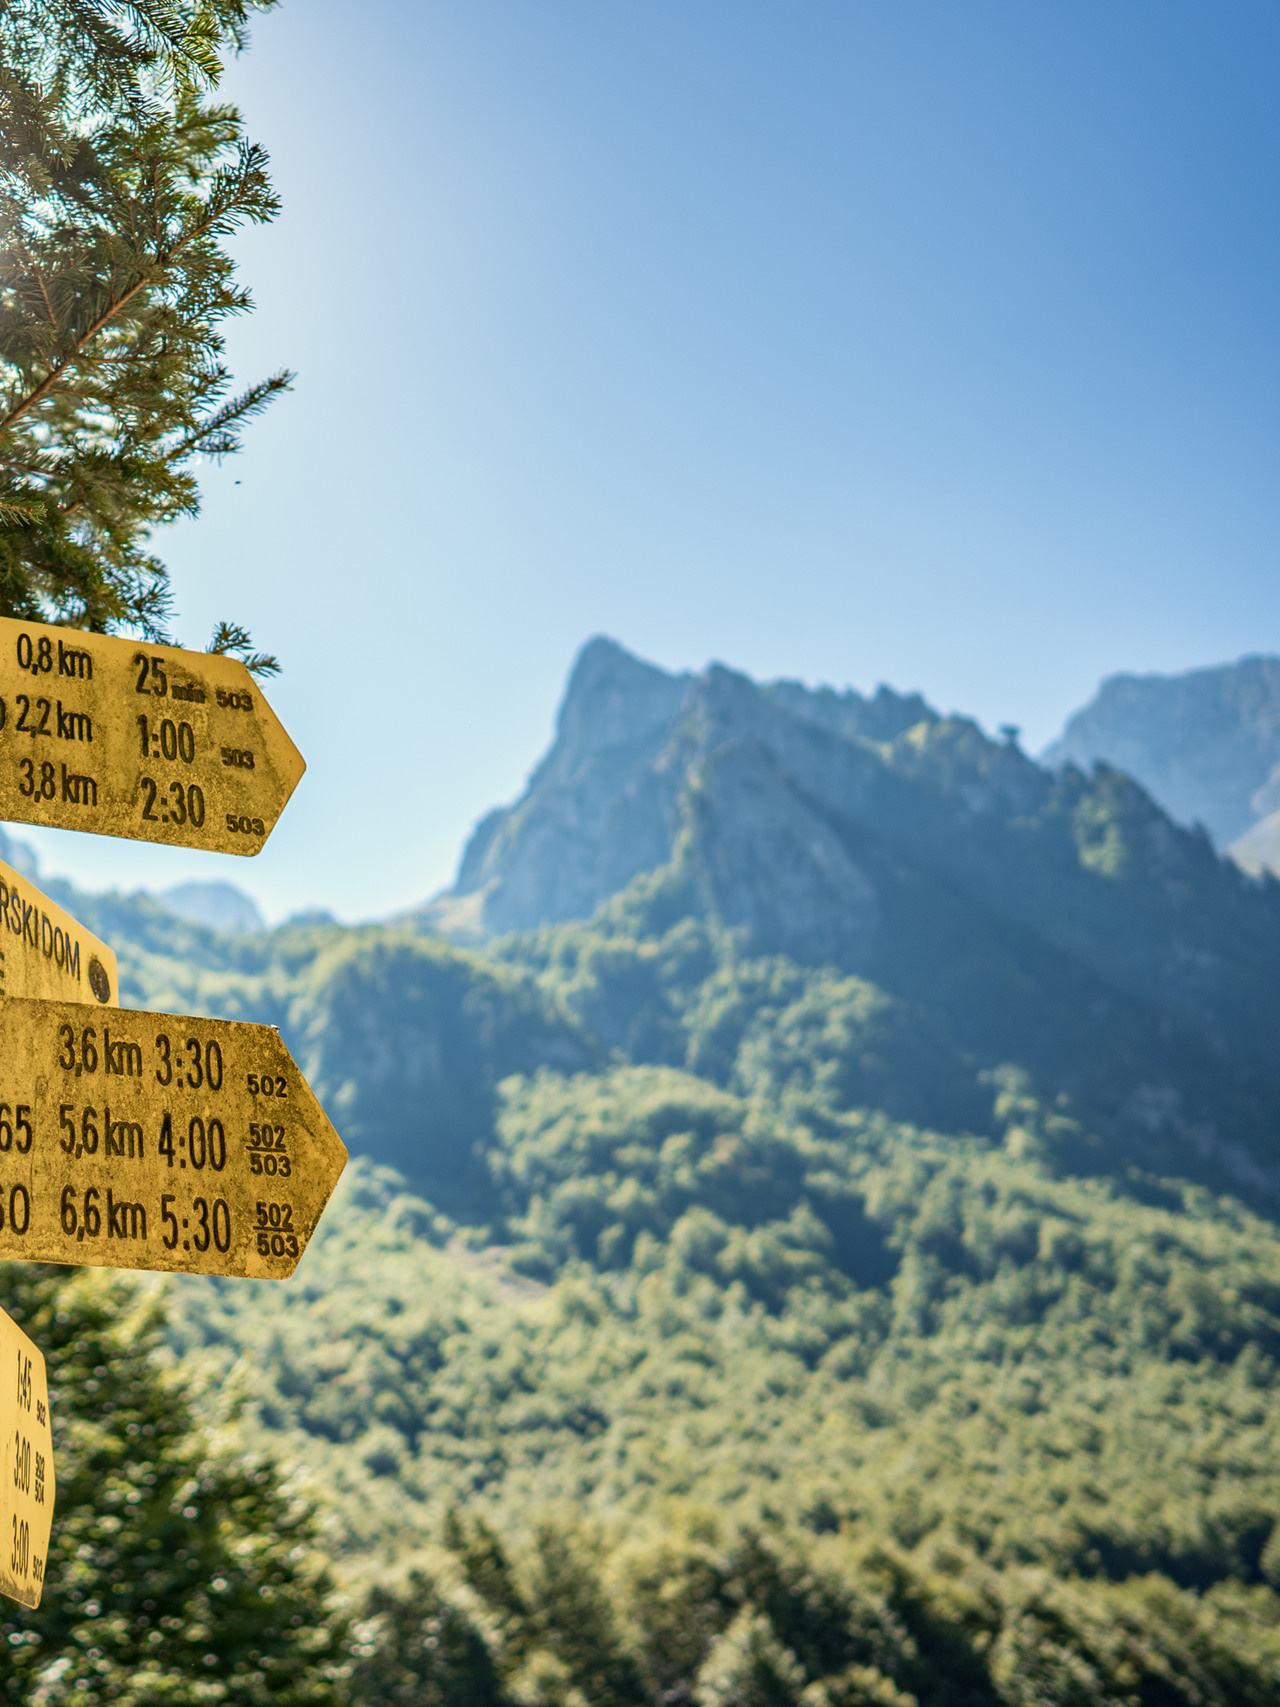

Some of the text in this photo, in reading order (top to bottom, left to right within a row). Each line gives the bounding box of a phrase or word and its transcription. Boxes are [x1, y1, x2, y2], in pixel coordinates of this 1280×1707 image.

[17, 633, 53, 676] 0,8
[58, 640, 92, 680] km
[134, 654, 168, 697] 25
[171, 683, 206, 704] min
[216, 690, 254, 712] 503
[15, 695, 52, 738] 2,2
[57, 700, 92, 743] km
[136, 714, 195, 764] 1:00
[220, 746, 255, 770] 503
[19, 758, 55, 804] 3,8
[61, 763, 98, 807] km
[140, 776, 205, 828] 2:30
[226, 813, 266, 837] 503
[59, 1024, 98, 1077] 3,6
[104, 1028, 142, 1077] km
[155, 1033, 223, 1091] 3:30
[246, 1073, 288, 1098] 502
[59, 1103, 99, 1159] 5,6
[105, 1107, 145, 1158] km
[158, 1112, 226, 1172] 4:00
[246, 1122, 286, 1149] 502
[249, 1153, 292, 1178] 503
[60, 1184, 101, 1242] 6,6
[107, 1189, 147, 1240] km
[161, 1193, 232, 1254] 5:30
[255, 1201, 294, 1227] 502
[256, 1232, 299, 1258] 503
[17, 1349, 32, 1412] 1:45
[36, 1399, 46, 1428] 502
[14, 1430, 31, 1495] 3:00
[12, 1513, 29, 1579] 3:00
[33, 1555, 43, 1583] 502
